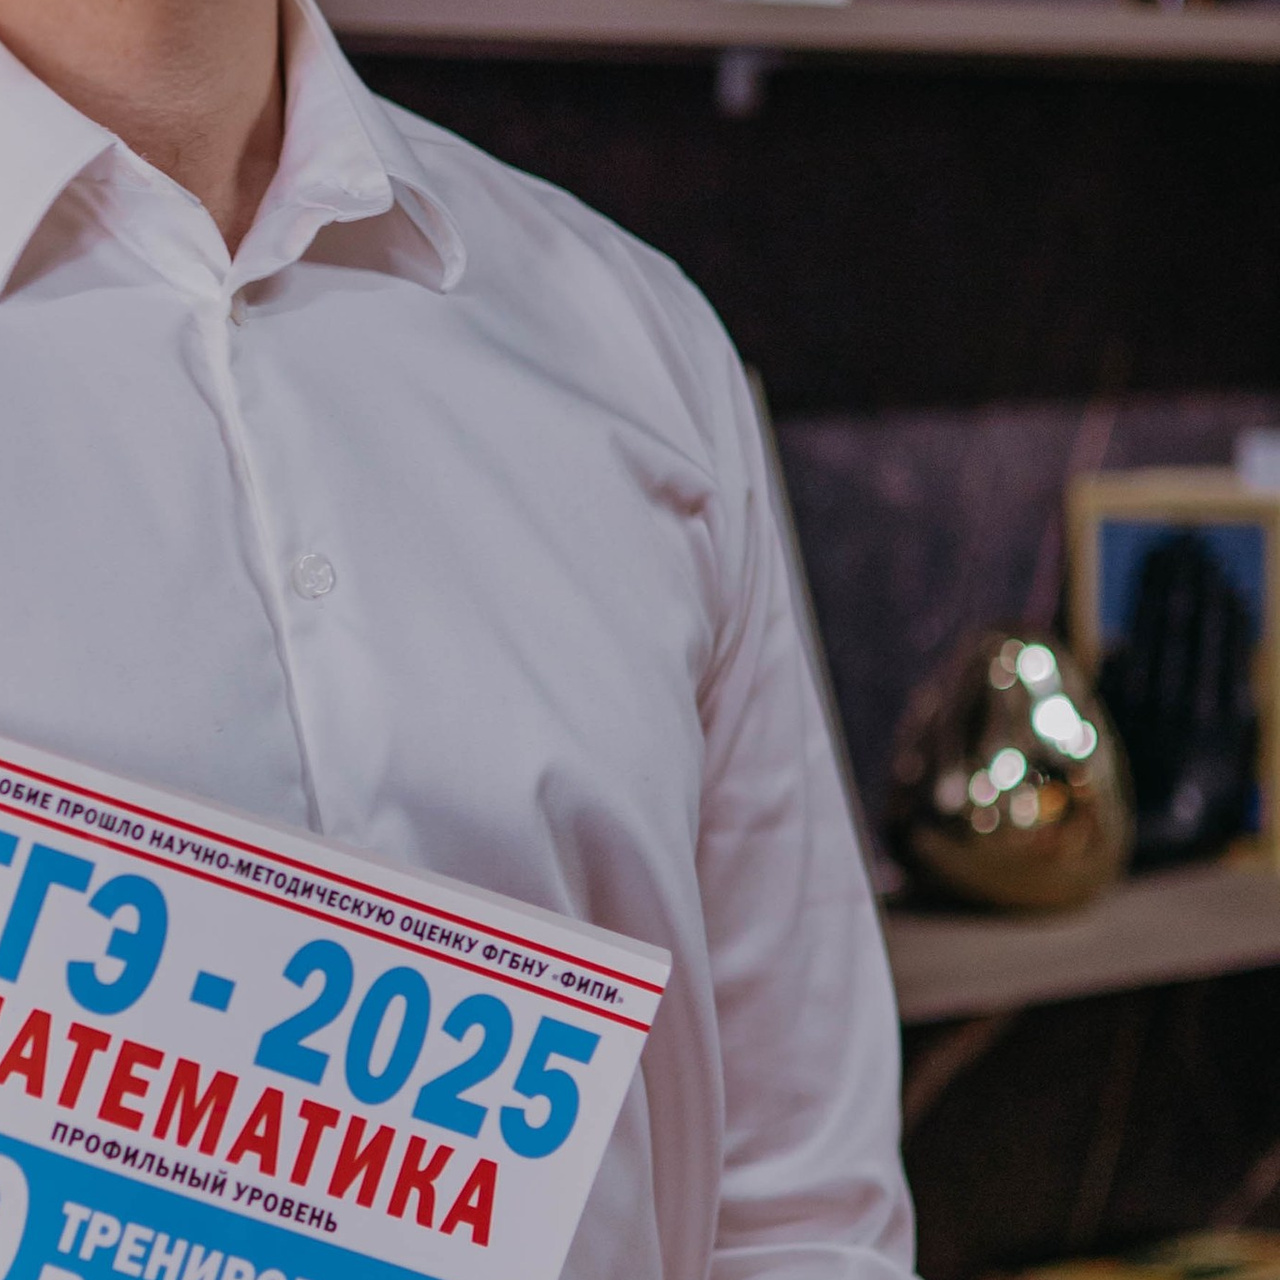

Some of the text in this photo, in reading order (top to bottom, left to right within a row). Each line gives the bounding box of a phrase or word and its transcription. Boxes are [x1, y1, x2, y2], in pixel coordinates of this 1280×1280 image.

[56, 798, 145, 841] ПРОШЛО
[149, 829, 396, 926] НАУЧНО-МЕТОДИЧЕСКУЮ
[400, 915, 479, 954] ОЦЕНКУ
[482, 943, 550, 979] ФГБНУ
[254, 940, 602, 1160] 2025
[51, 1122, 338, 1234] ПРОФИЛЬНЫЙ УРОВЕНЬ
